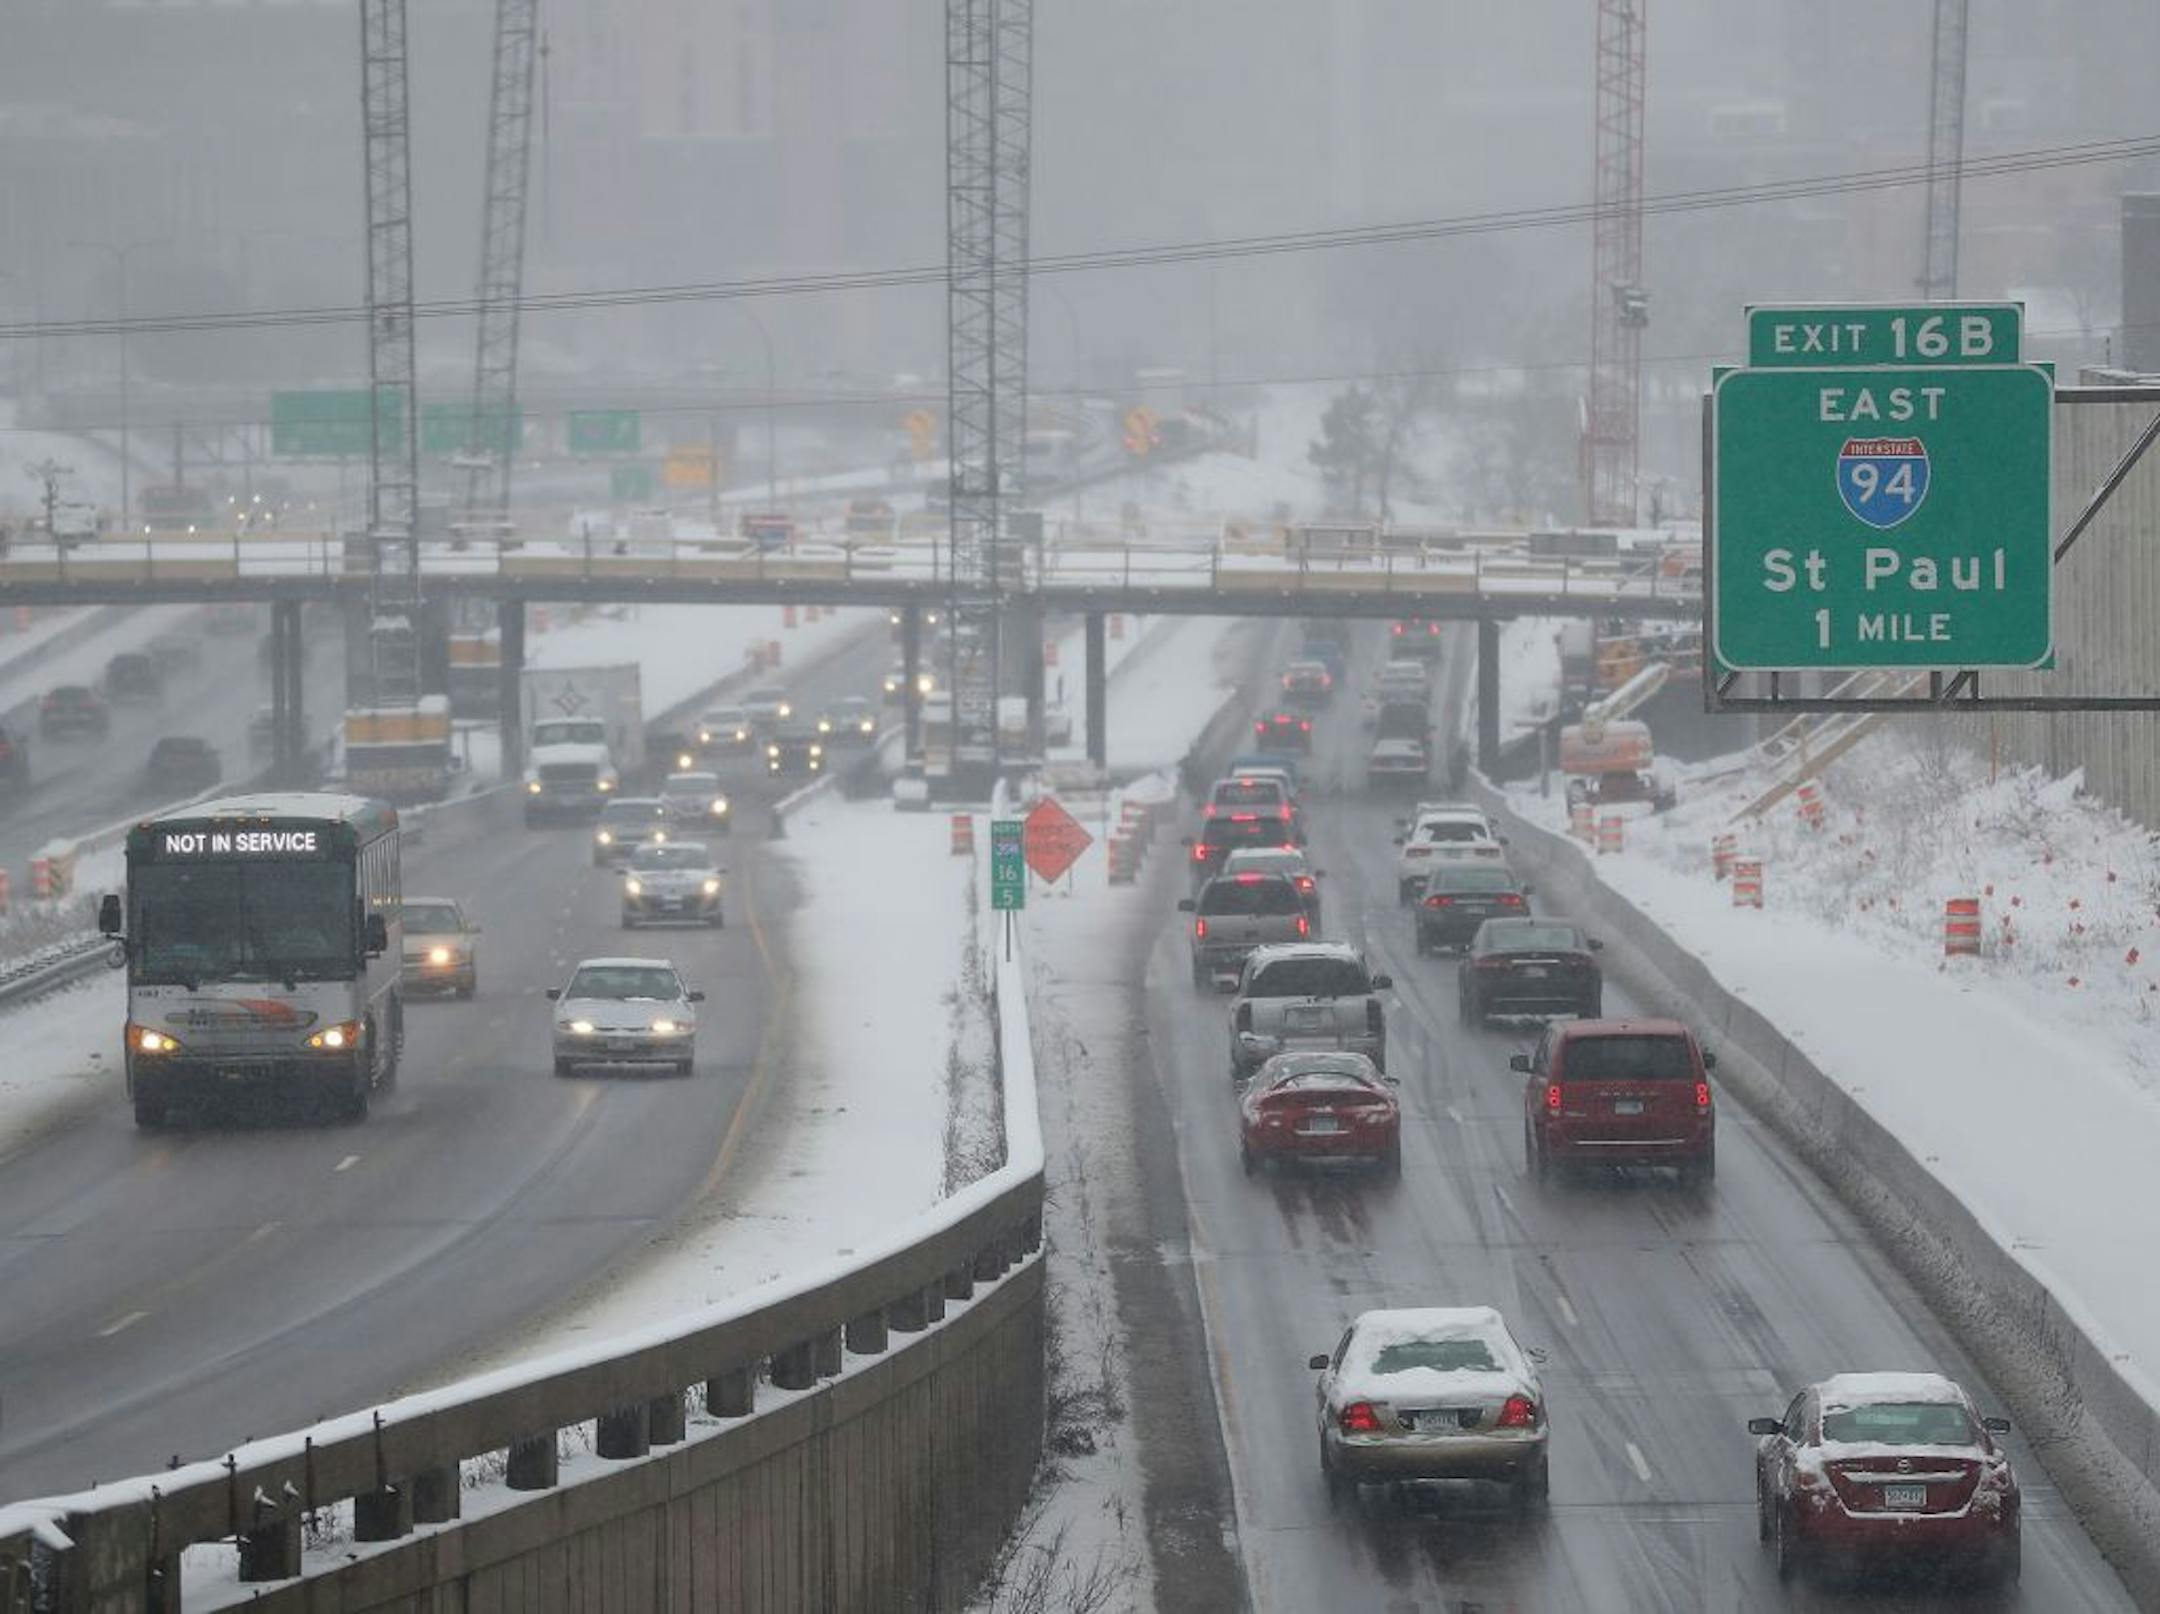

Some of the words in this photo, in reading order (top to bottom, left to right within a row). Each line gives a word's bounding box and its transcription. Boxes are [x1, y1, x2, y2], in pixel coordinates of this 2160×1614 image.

[1774, 324, 1866, 353] EXIT
[1891, 315, 1994, 358] 16B
[1819, 387, 1946, 421] EAST
[1850, 443, 1915, 455] INTERSTATE
[1851, 463, 1916, 504] 94
[1763, 548, 1827, 592] St
[1865, 547, 2005, 591] Paul
[1815, 608, 1831, 649] 1
[1858, 613, 1952, 641] MILE
[165, 834, 206, 854] NOT
[212, 834, 231, 852] IN
[235, 832, 317, 852] SERVICE
[998, 864, 1018, 880] 16
[1003, 888, 1014, 906] 5
